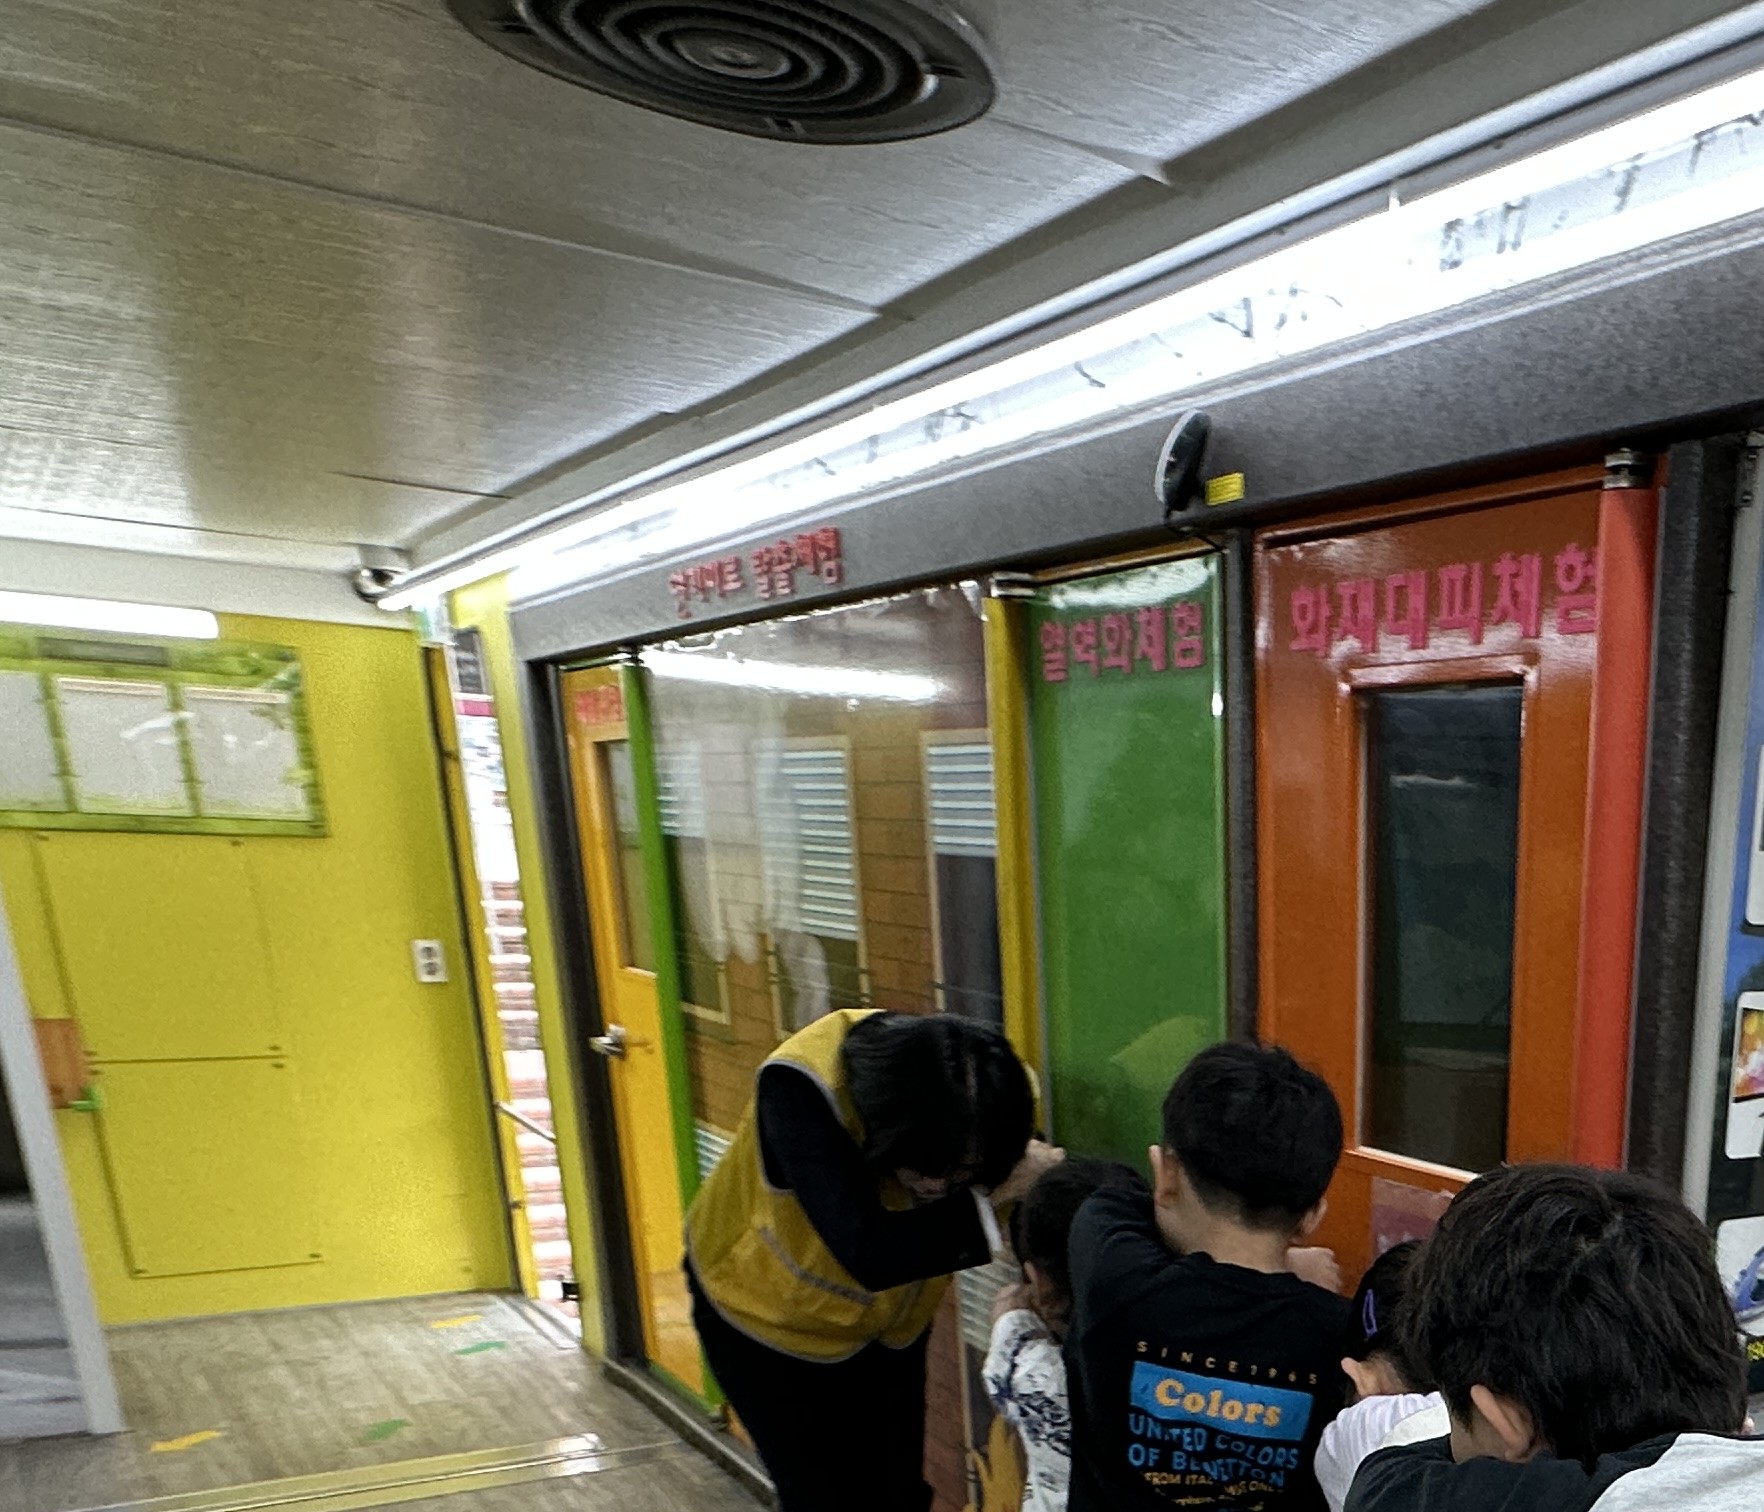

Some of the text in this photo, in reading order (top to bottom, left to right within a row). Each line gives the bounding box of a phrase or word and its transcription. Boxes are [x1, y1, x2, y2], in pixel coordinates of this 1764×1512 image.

[1290, 543, 1597, 658] 화재대피체험
[1155, 1378, 1282, 1428] Colors
[1128, 1413, 1299, 1469] UNITED COLORS
[1128, 1443, 1160, 1466] OF
